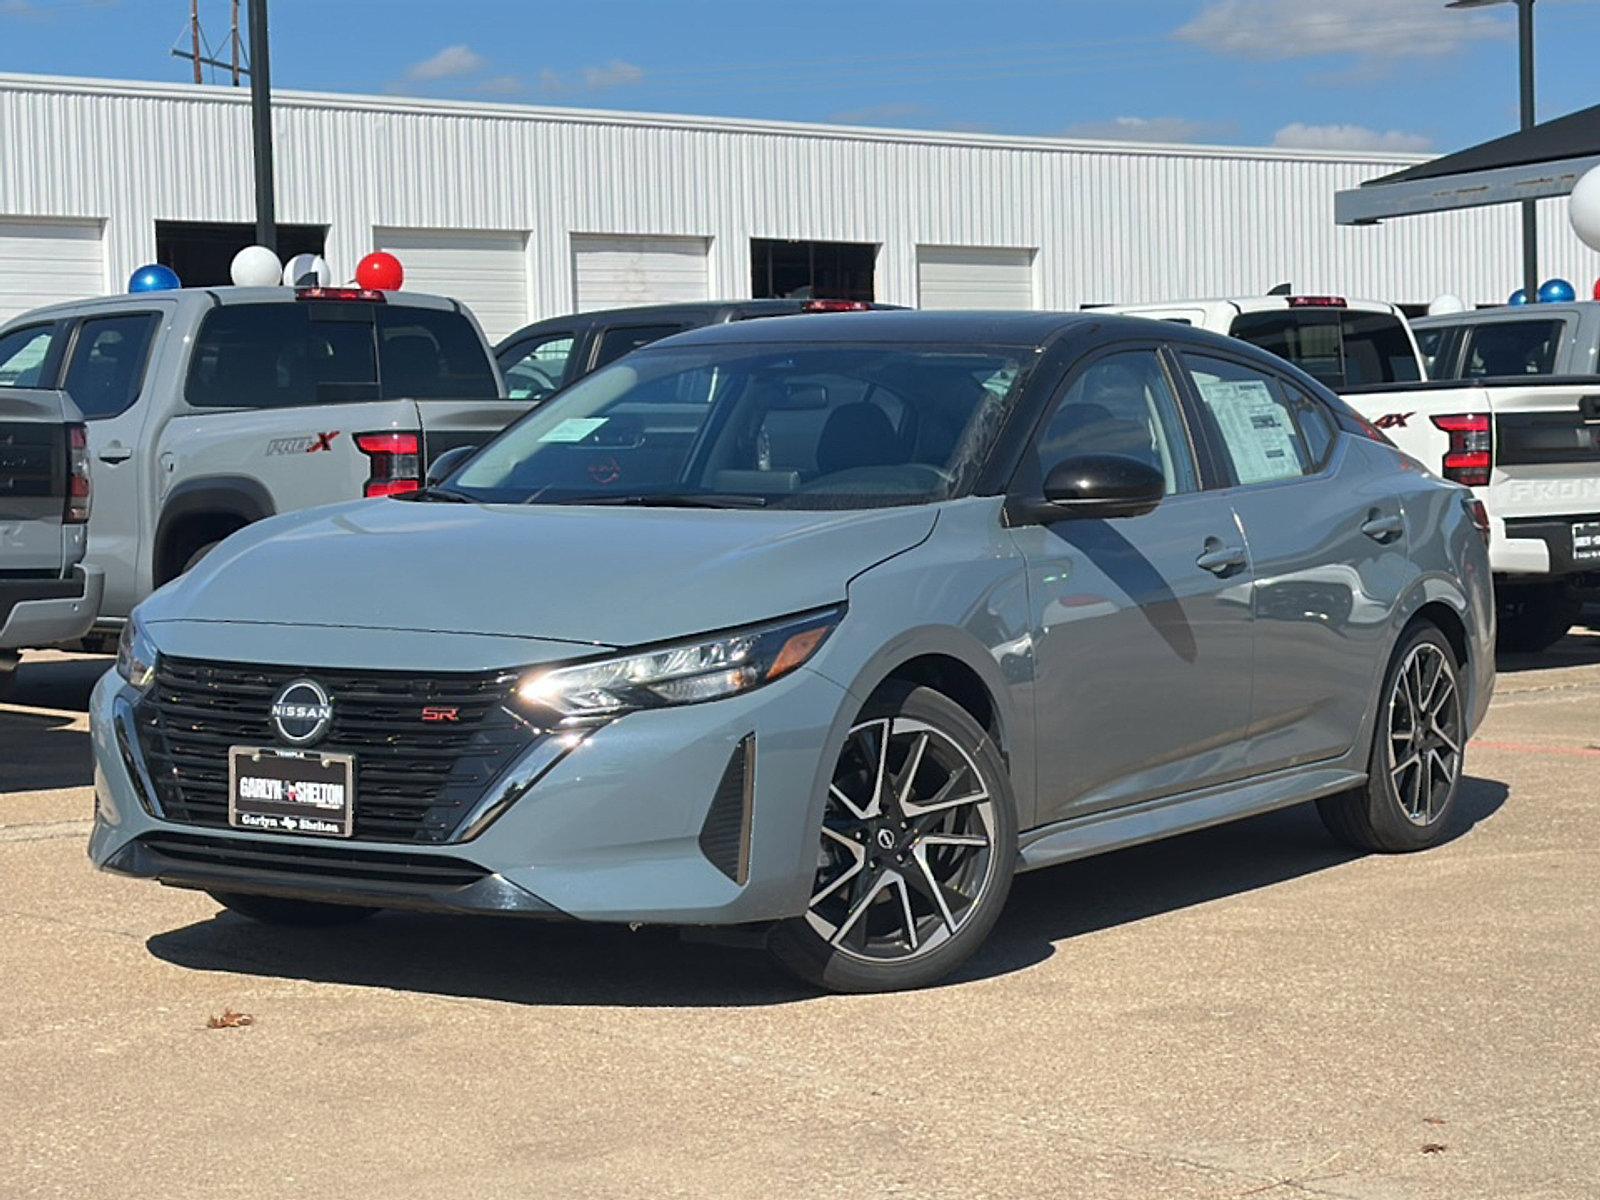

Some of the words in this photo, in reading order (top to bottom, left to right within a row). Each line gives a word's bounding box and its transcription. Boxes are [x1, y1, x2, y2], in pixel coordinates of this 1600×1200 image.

[272, 704, 332, 719] NISSAN
[423, 706, 460, 721] SR
[240, 777, 282, 800] GARLYN
[295, 782, 344, 805] SHELTON
